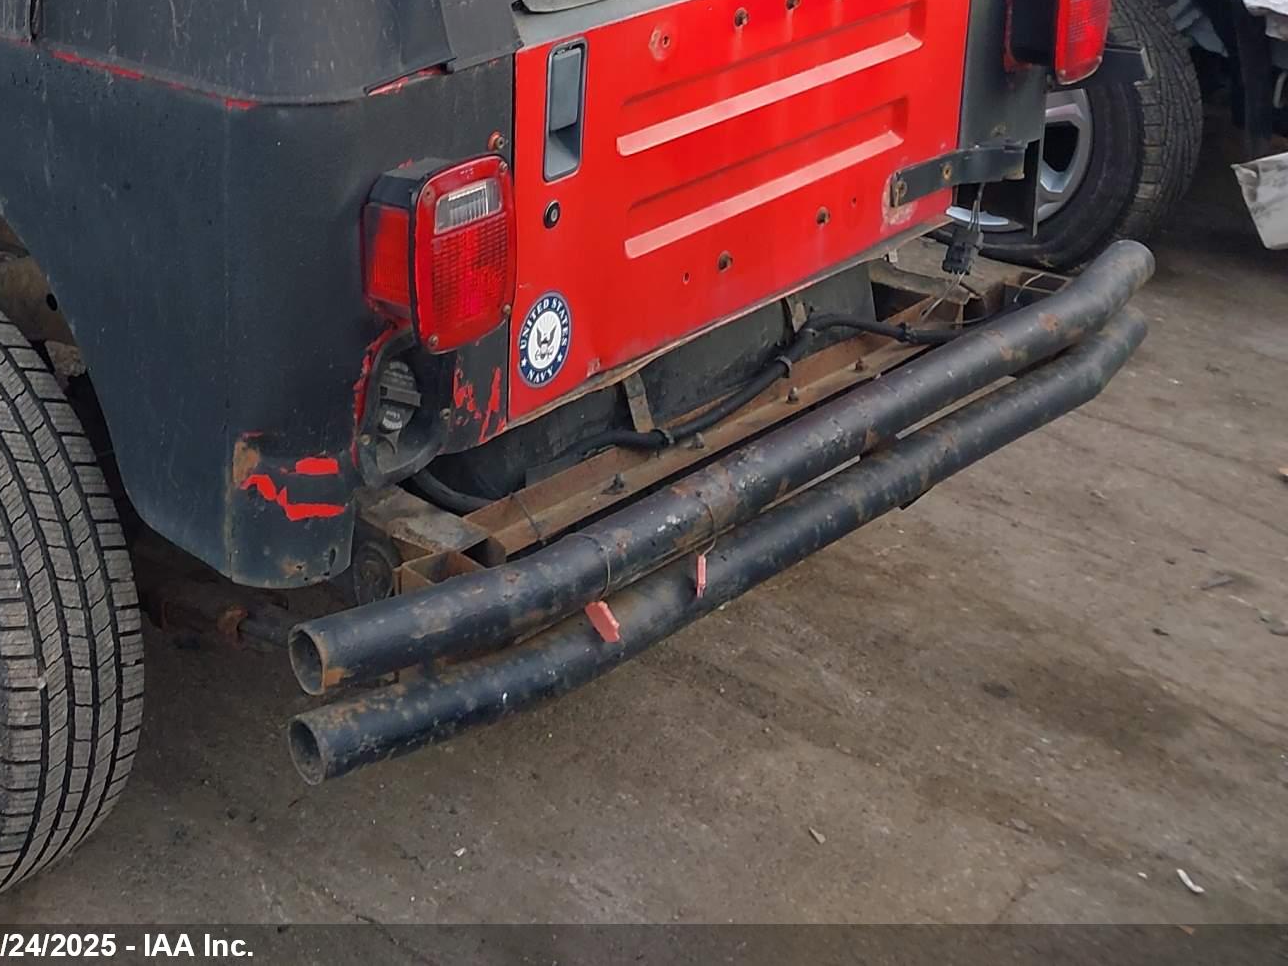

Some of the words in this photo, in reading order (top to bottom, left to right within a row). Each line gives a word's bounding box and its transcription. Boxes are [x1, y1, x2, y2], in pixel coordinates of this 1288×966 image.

[519, 298, 550, 350] UNITED
[551, 297, 569, 346] STATES
[526, 366, 554, 383] NAVY
